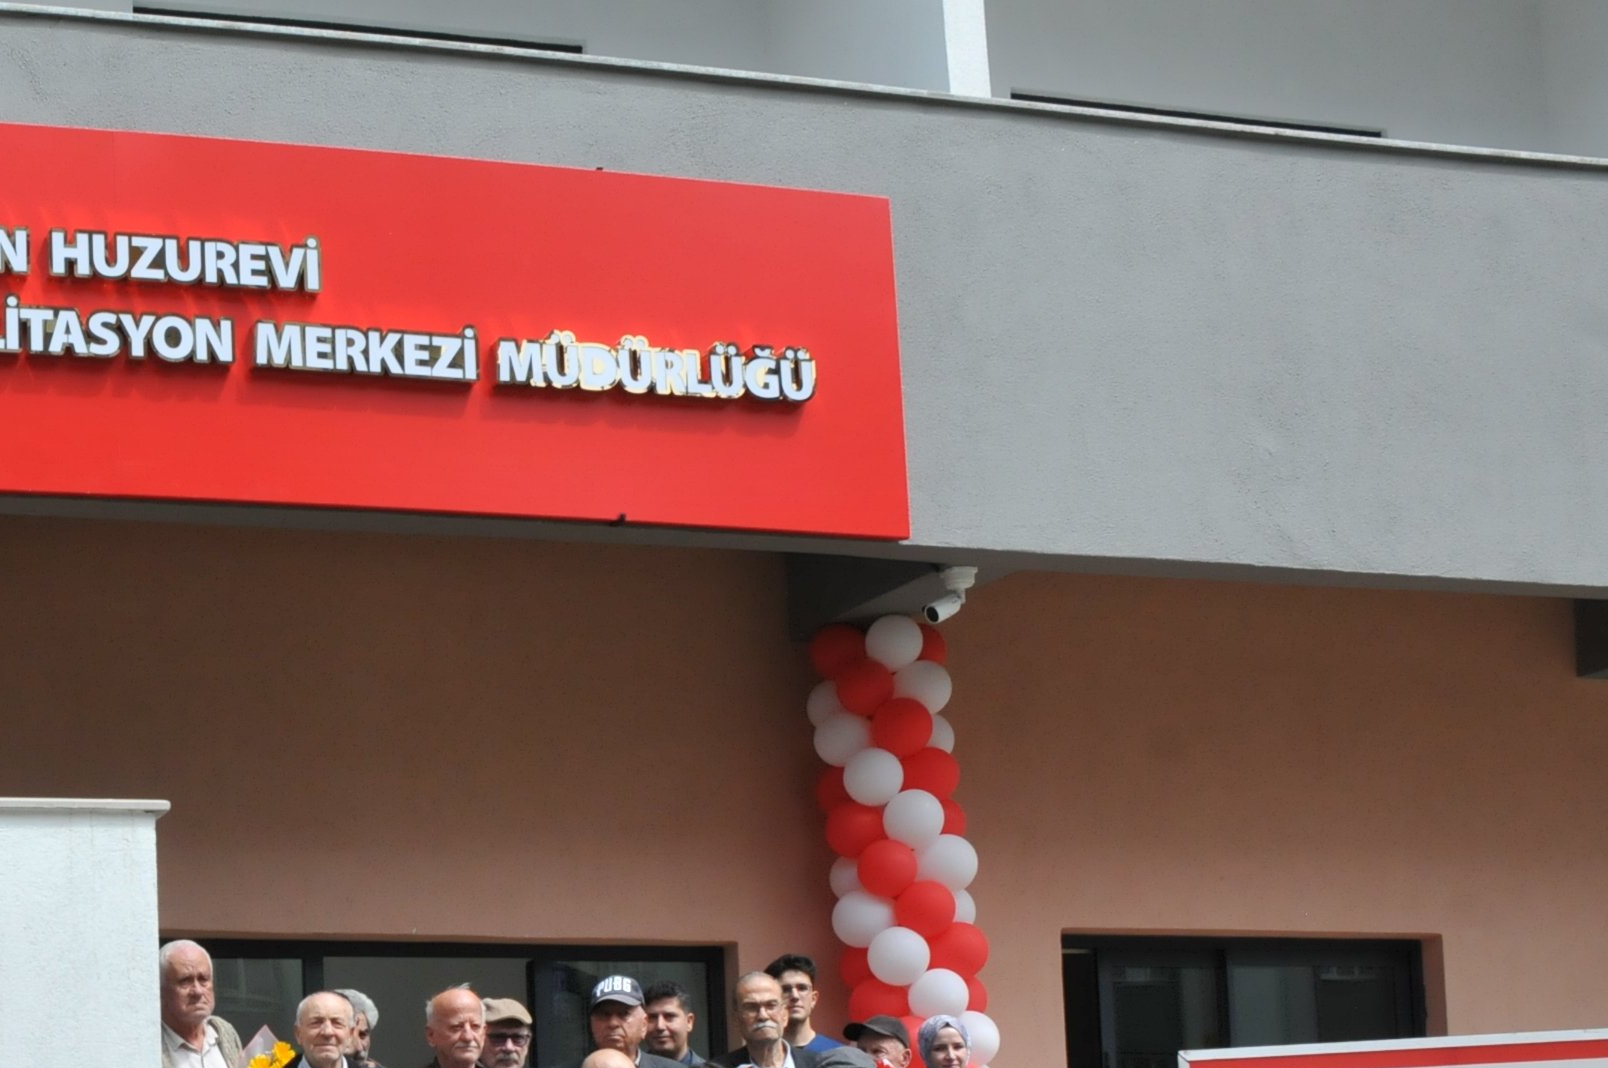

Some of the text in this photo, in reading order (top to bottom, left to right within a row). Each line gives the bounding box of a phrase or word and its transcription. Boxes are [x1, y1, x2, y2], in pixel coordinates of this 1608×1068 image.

[49, 230, 323, 292] HUZUREVİ
[254, 321, 480, 380] MERKEZİ
[497, 331, 816, 401] MÜDÜRLÜĞÜ
[596, 975, 632, 998] PUBG
